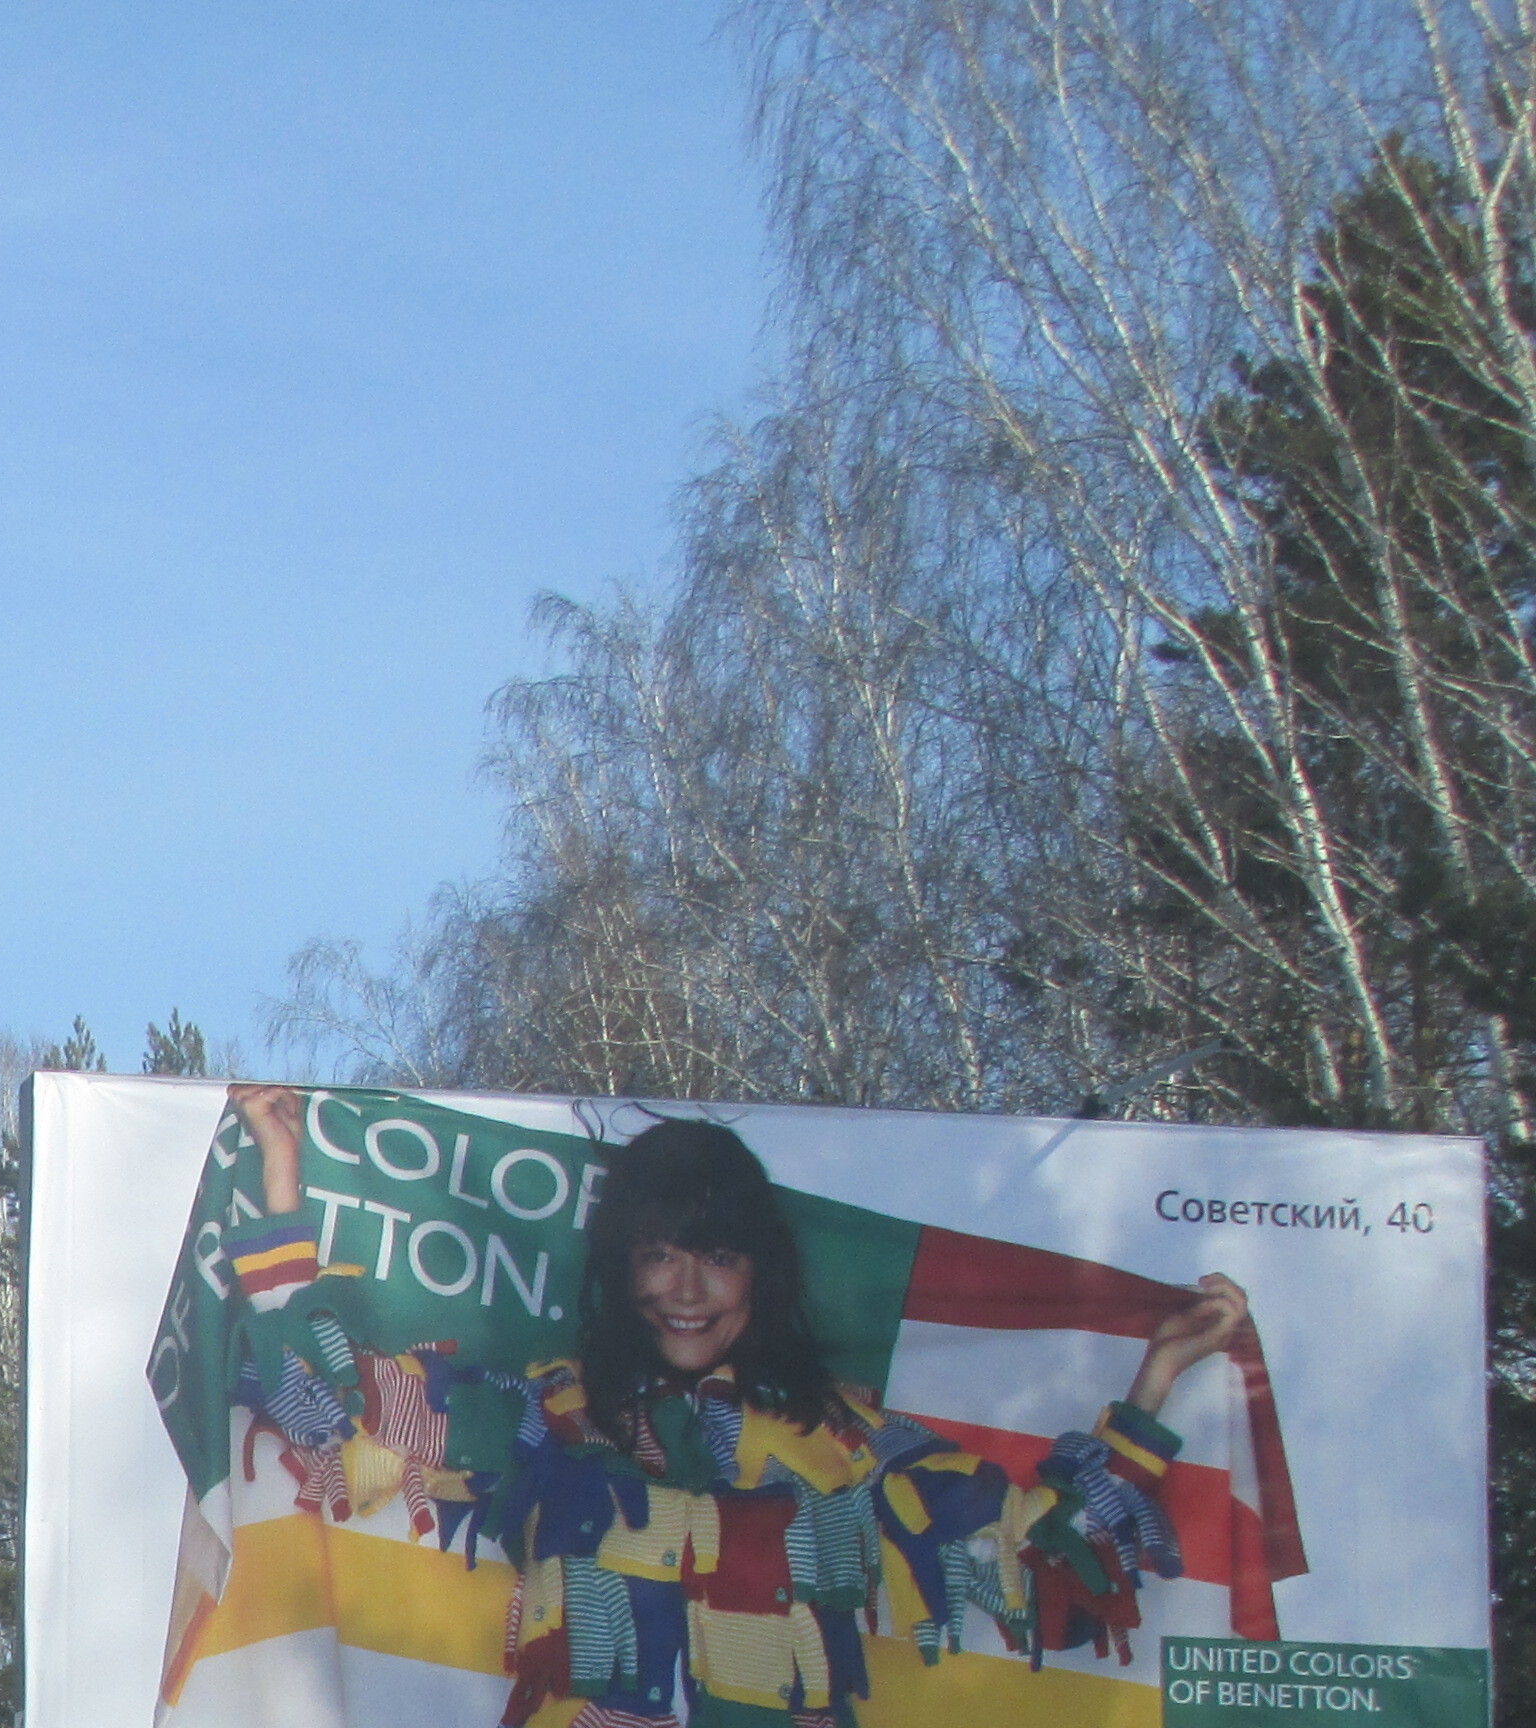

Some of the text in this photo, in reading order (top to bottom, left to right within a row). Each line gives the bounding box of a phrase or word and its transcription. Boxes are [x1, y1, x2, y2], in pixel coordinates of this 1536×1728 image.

[1154, 1189, 1435, 1237] Советский, 40
[1168, 1645, 1414, 1680] UNITED COLORS
[1168, 1679, 1382, 1713] OF BENETTON.
